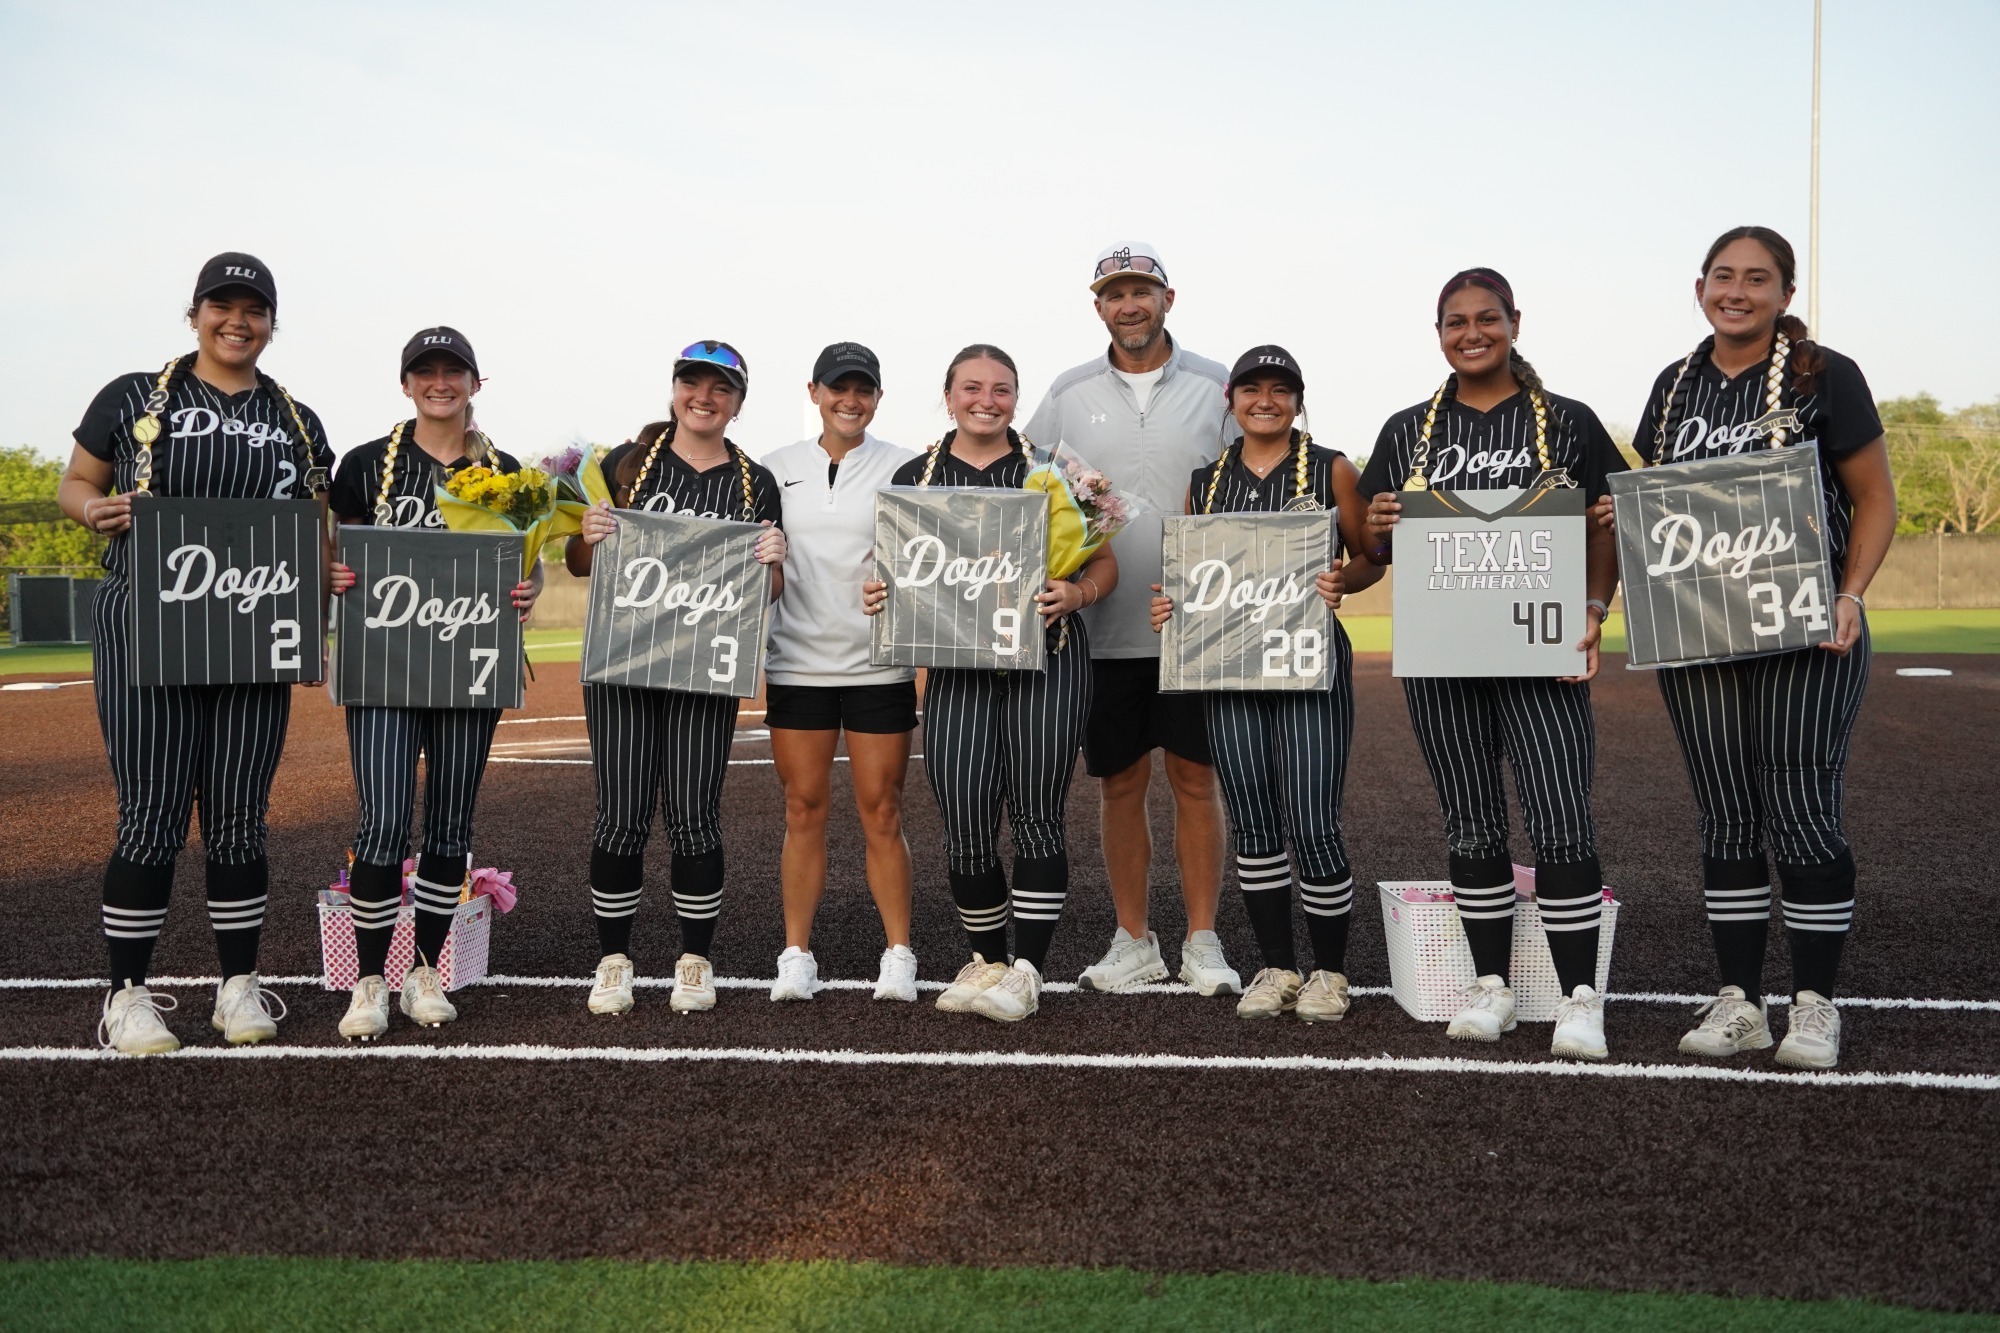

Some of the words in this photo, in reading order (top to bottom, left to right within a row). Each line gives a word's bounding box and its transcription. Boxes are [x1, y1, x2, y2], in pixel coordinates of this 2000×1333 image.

[225, 266, 257, 279] TLU
[423, 335, 452, 345] TLU
[1258, 355, 1286, 366] TLU
[145, 389, 169, 413] 2
[169, 407, 294, 448] Dogs
[1673, 415, 1763, 462] Dog
[135, 450, 153, 481] 2
[1410, 439, 1431, 469] 2
[1429, 443, 1532, 486] Dogs
[272, 460, 297, 499] 2
[896, 535, 1022, 600] Dogs
[1428, 531, 1553, 573] TEXAS
[1647, 513, 1796, 579] Dogs
[160, 545, 299, 613] Dogs
[614, 557, 743, 625] Dogs
[1183, 559, 1307, 623] Dogs
[1428, 573, 1551, 591] LUTHERAN
[365, 575, 500, 641] Dogs
[1512, 601, 1563, 645] 40
[1747, 576, 1829, 637] 34
[270, 620, 301, 669] 2
[991, 608, 1021, 656] 9
[1262, 629, 1321, 677] 28
[469, 649, 499, 695] 7
[708, 636, 739, 682] 3
